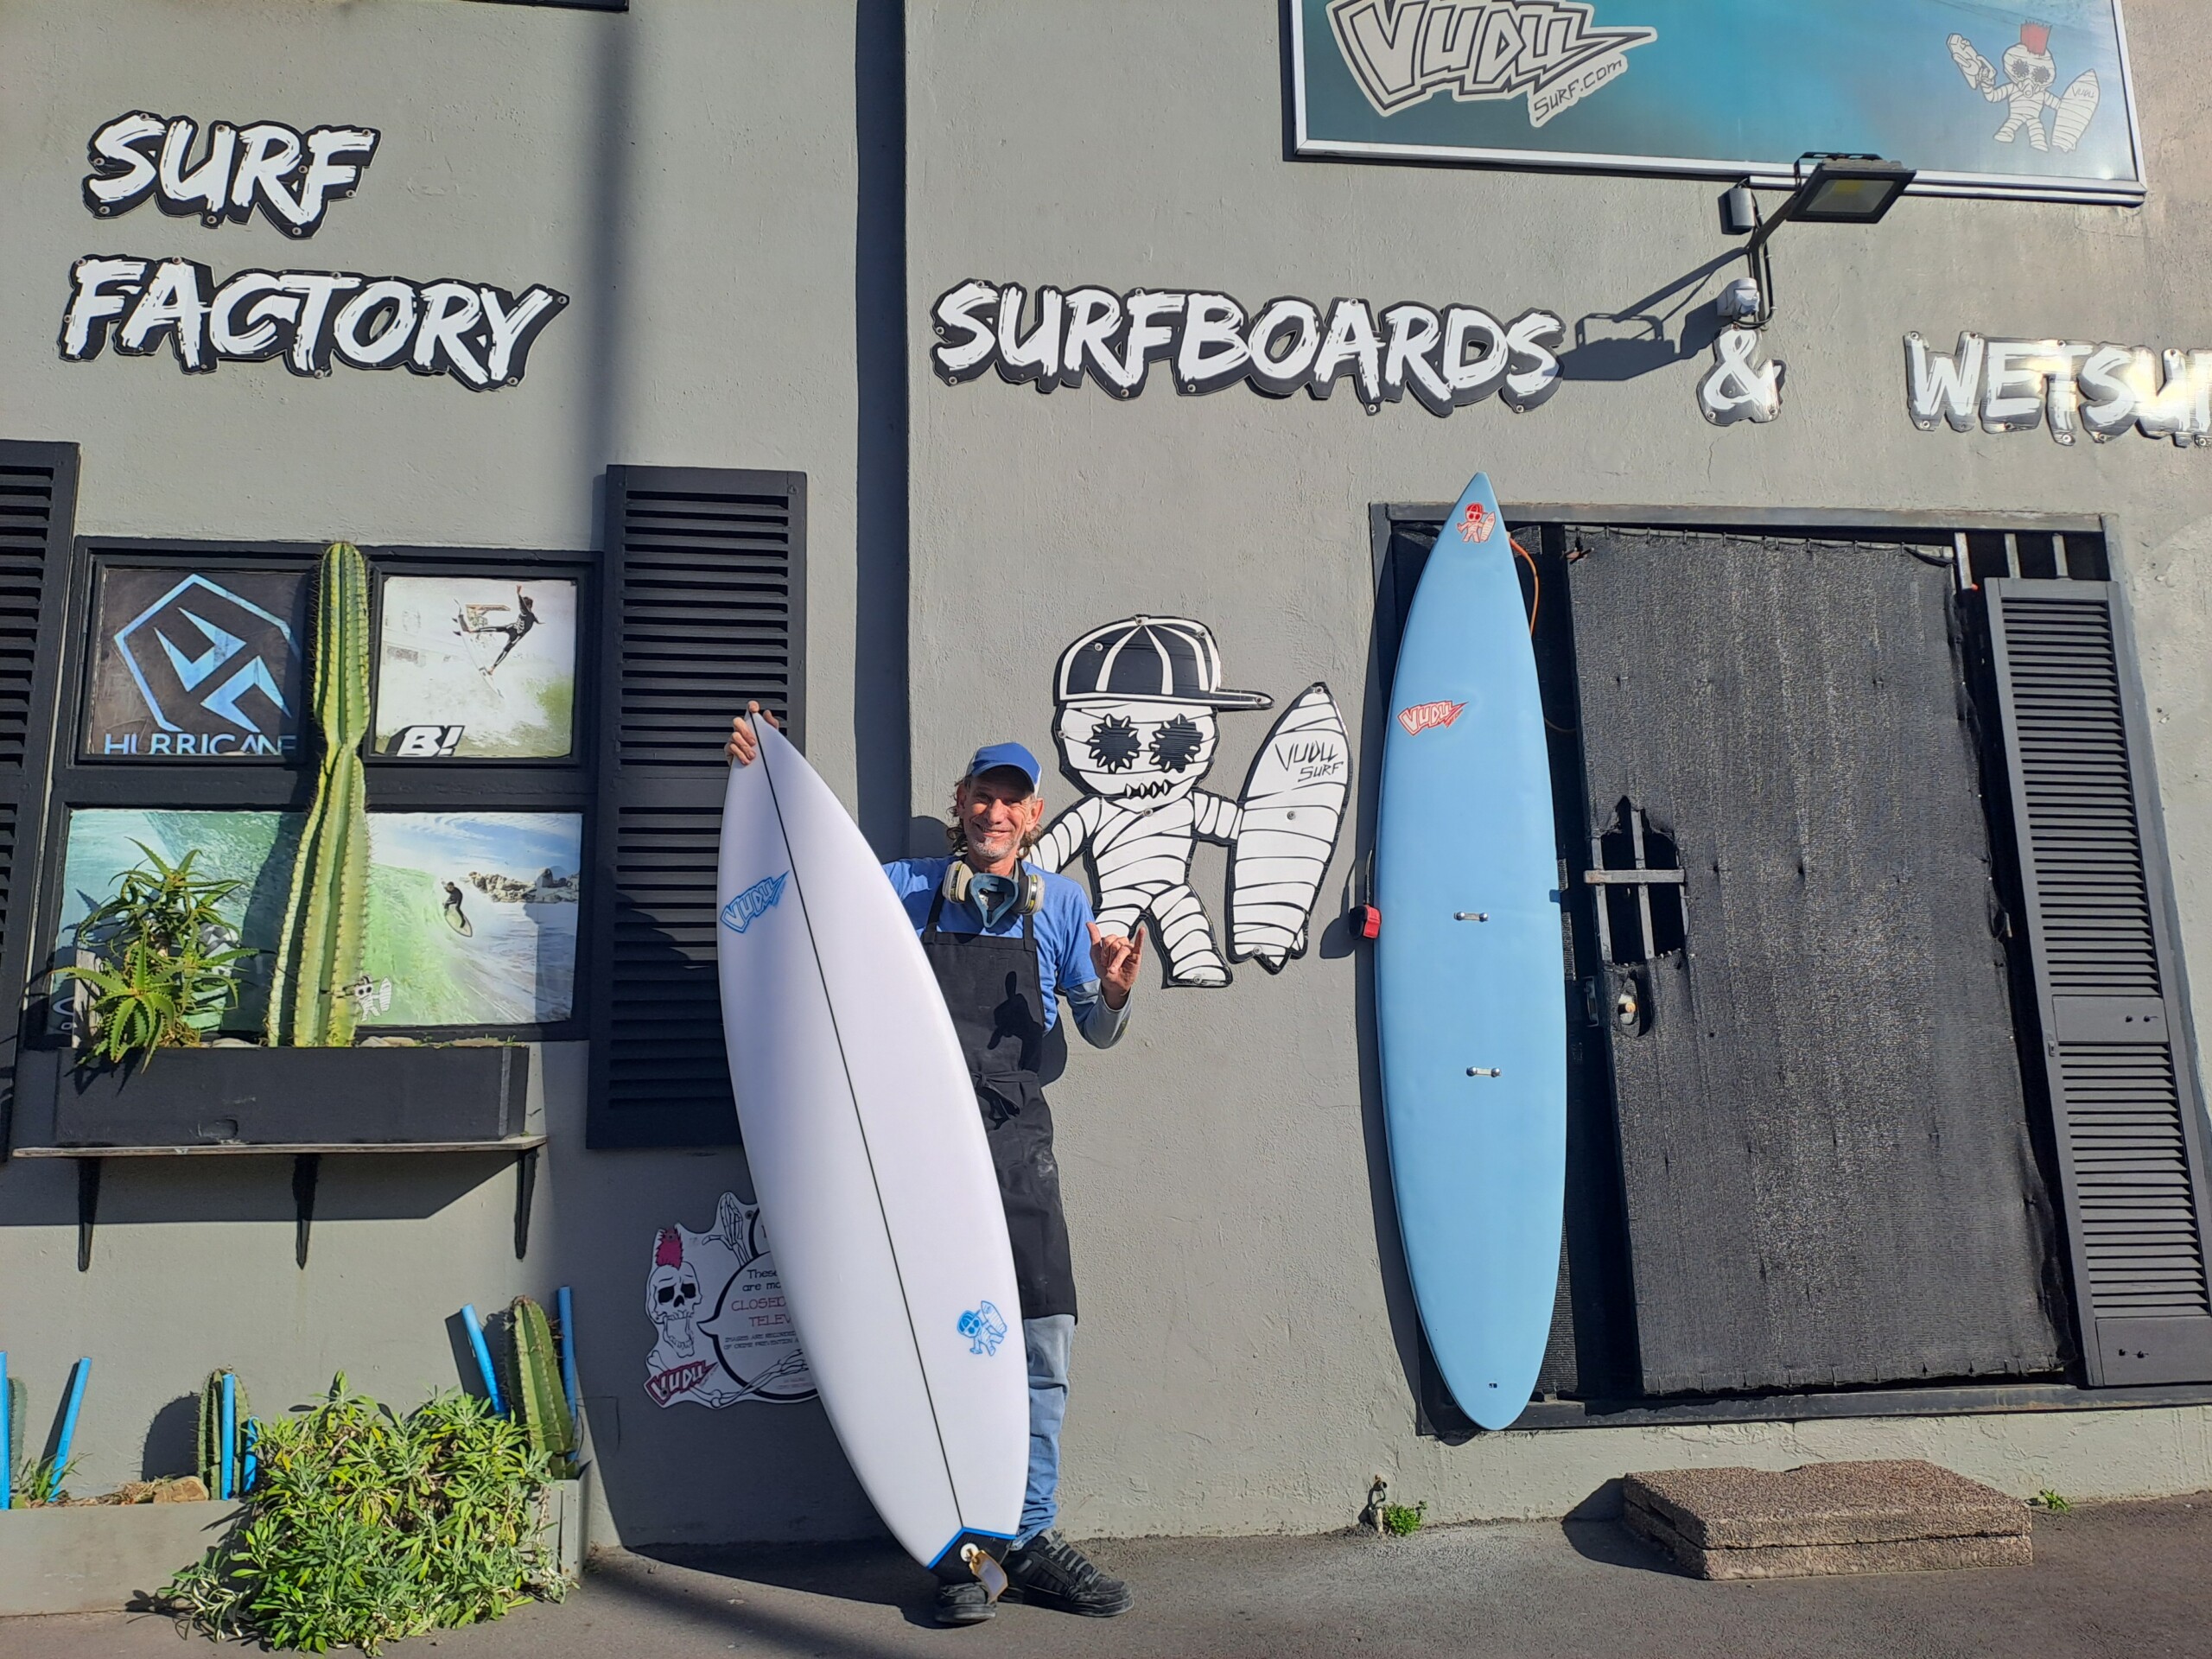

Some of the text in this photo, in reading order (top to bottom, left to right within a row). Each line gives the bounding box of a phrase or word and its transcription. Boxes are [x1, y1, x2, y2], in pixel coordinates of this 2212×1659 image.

[1333, 0, 1652, 110] VUDU
[87, 113, 376, 226] SURF
[63, 258, 554, 385] FACTORY
[936, 282, 1563, 400] SURFBOARDS
[1703, 328, 1778, 411] &
[1397, 700, 1469, 736] VUDU
[1274, 741, 1338, 772] VUDU
[1297, 761, 1344, 783] SURF
[720, 869, 790, 933] VUDU
[731, 1296, 786, 1311] CLOSED
[742, 1283, 761, 1292] are
[748, 1313, 791, 1327] TELEV
[645, 1359, 718, 1406] VUDU
